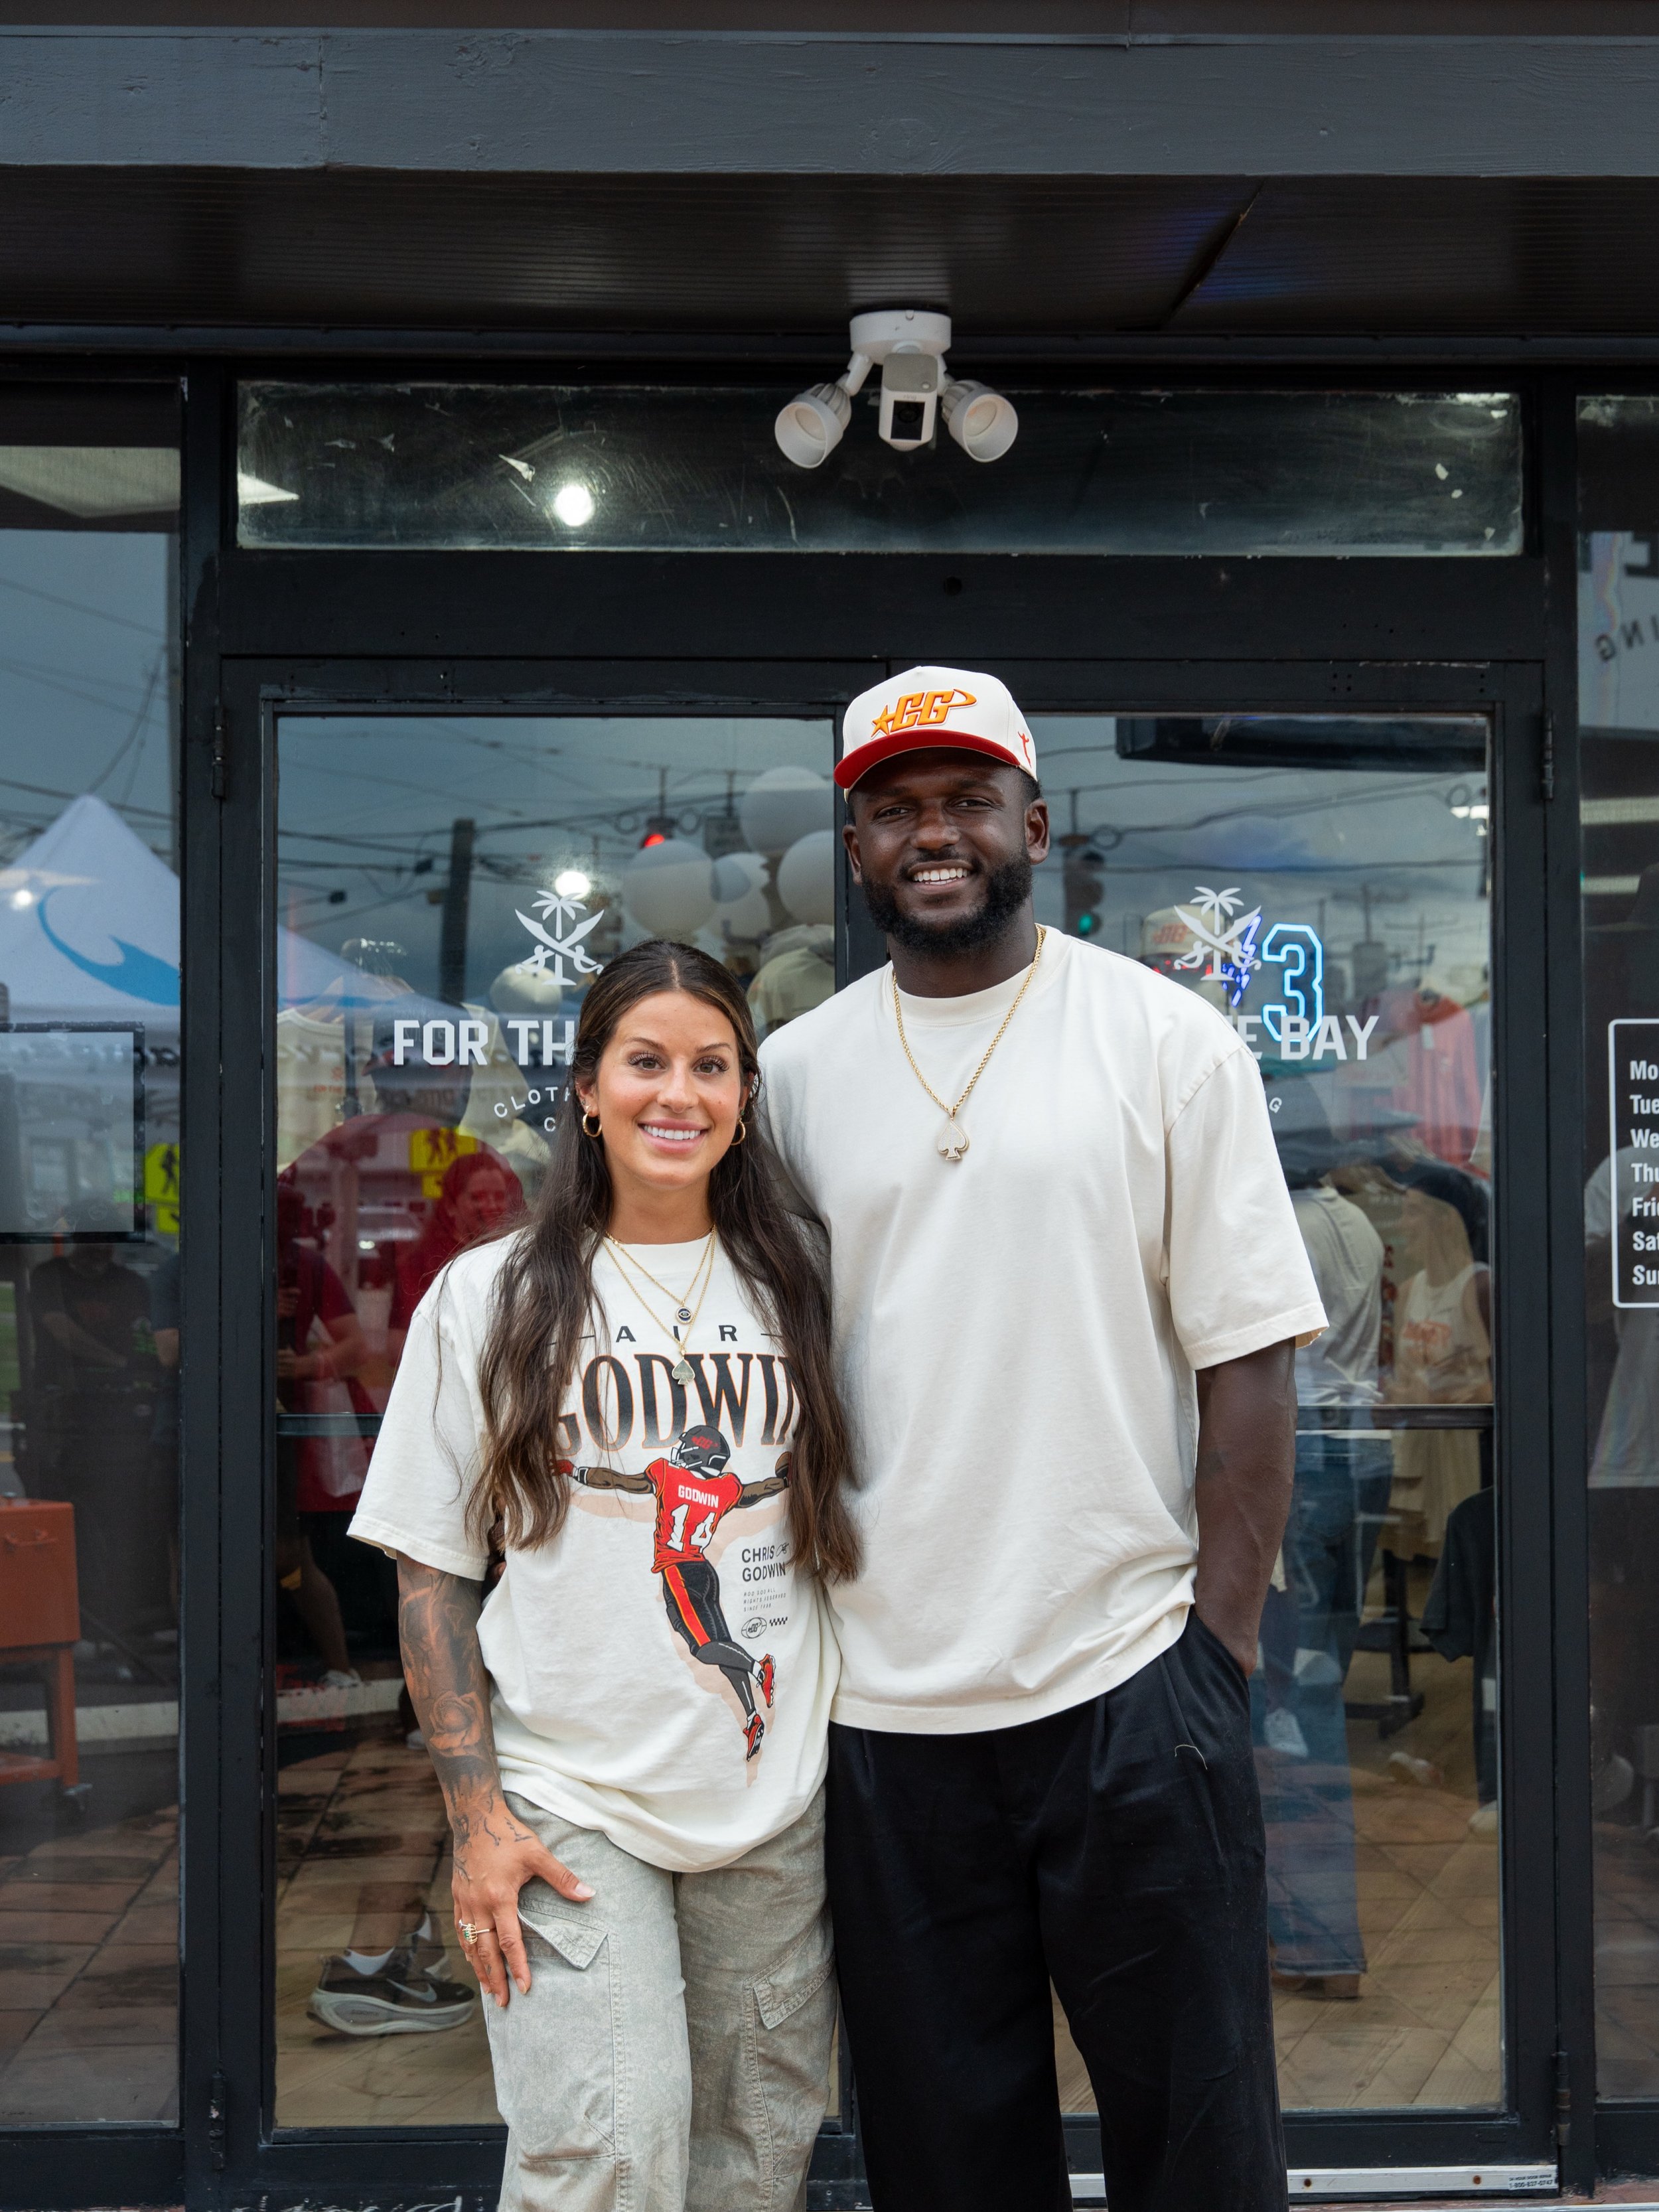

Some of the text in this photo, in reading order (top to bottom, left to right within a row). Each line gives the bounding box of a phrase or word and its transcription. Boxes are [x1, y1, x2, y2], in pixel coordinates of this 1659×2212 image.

[394, 1019, 575, 1065] FOR TH
[1280, 1015, 1380, 1061] BAY
[1629, 1060, 1659, 1081] Mo
[1629, 1094, 1659, 1115] Tue
[1632, 1196, 1659, 1217] Fri
[1632, 1264, 1659, 1286] Su
[616, 1324, 738, 1343] AIR
[678, 1485, 719, 1508] GODWIN
[666, 1503, 717, 1553] 14
[741, 1545, 775, 1563] CHRIS
[742, 1562, 786, 1582] GODWIN
